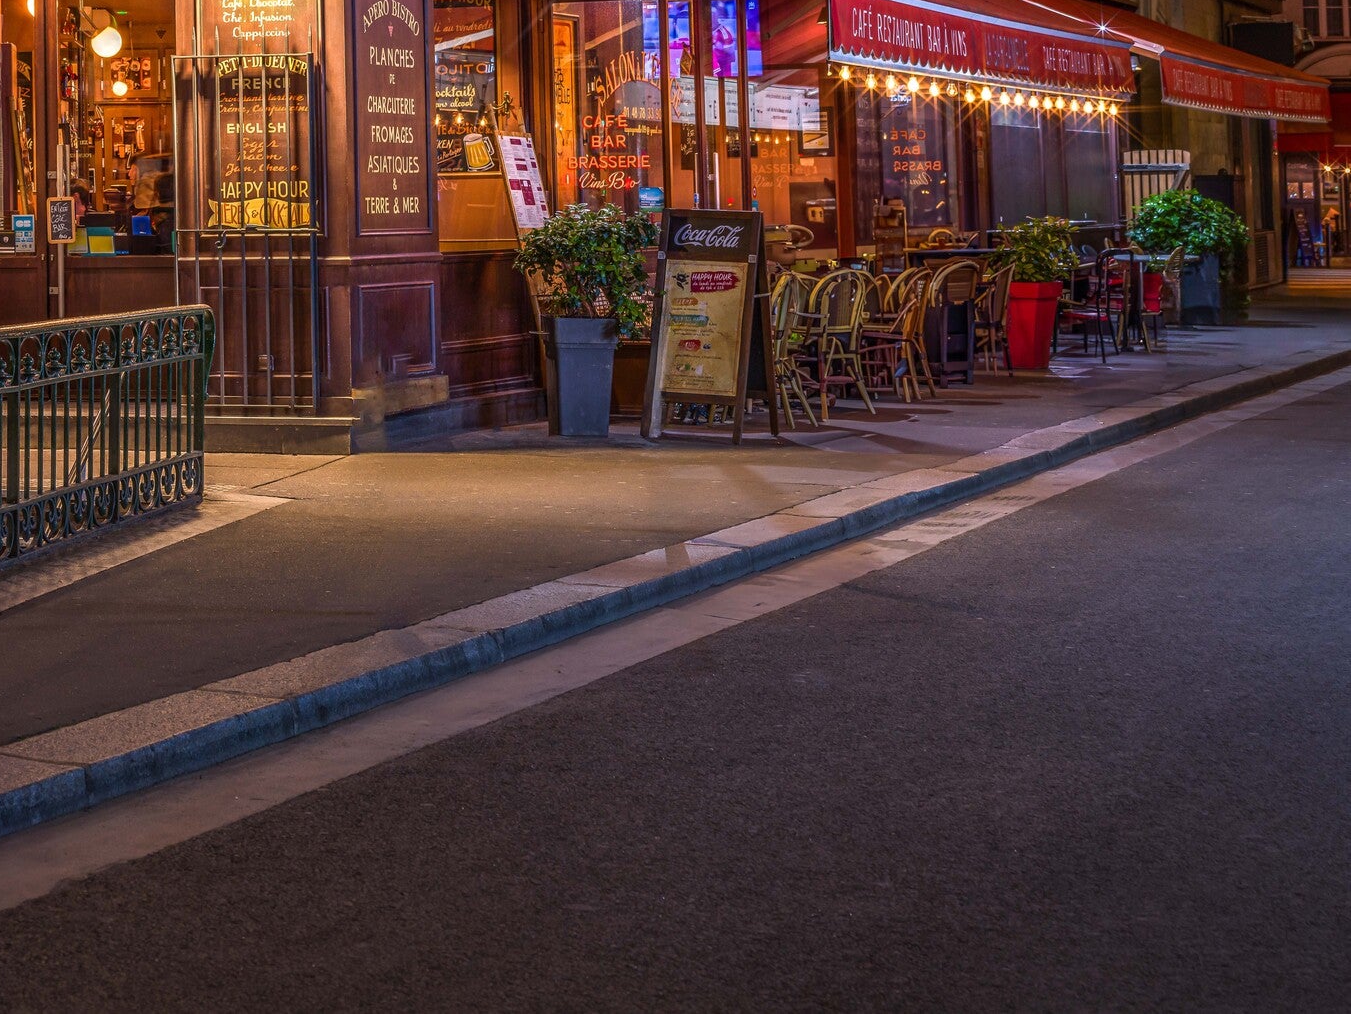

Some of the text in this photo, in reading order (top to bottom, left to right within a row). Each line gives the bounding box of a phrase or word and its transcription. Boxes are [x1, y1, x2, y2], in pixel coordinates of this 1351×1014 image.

[363, 0, 420, 36] APERO BISTRO
[852, 6, 968, 58] CAFÉ RESTAURANT BAR À VINS
[370, 46, 415, 68] PLANCHES
[390, 74, 396, 84] DE
[594, 50, 635, 108] SALON
[368, 96, 416, 115] CHARCUTERIE
[450, 97, 474, 108] alcool
[226, 122, 288, 134] ENGLSH
[372, 126, 414, 144] FROMAGES
[591, 135, 627, 148] BAR
[368, 155, 420, 175] ASIATIQUES
[568, 154, 651, 170] BRASSERIE
[268, 180, 309, 198] HOUR
[392, 178, 398, 190] &
[579, 171, 640, 190] Vins Bio
[252, 210, 258, 218] &
[365, 196, 420, 214] TERRE & MER
[692, 272, 733, 283] HAPPY HOUR
